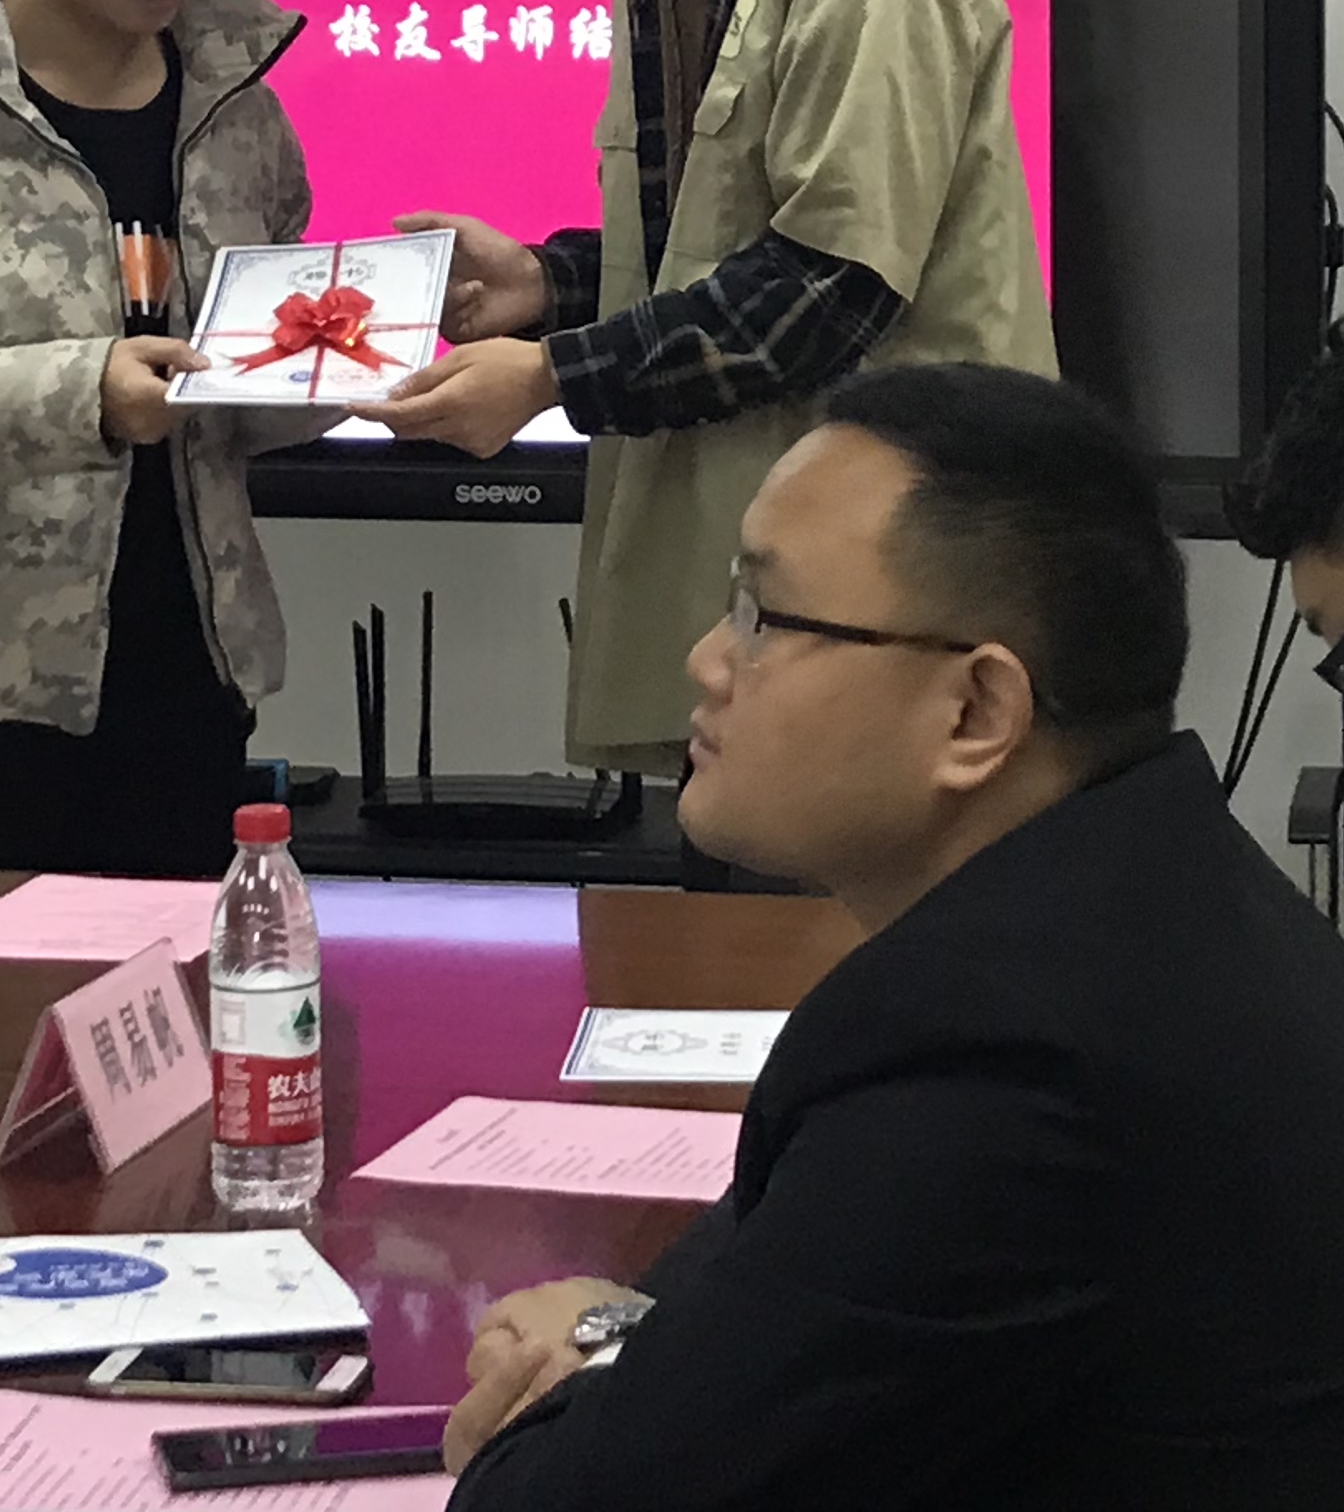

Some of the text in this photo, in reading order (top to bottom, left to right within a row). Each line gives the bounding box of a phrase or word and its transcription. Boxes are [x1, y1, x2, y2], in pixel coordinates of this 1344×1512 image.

[328, 1, 615, 62] 校友导师结
[455, 483, 542, 505] seewo
